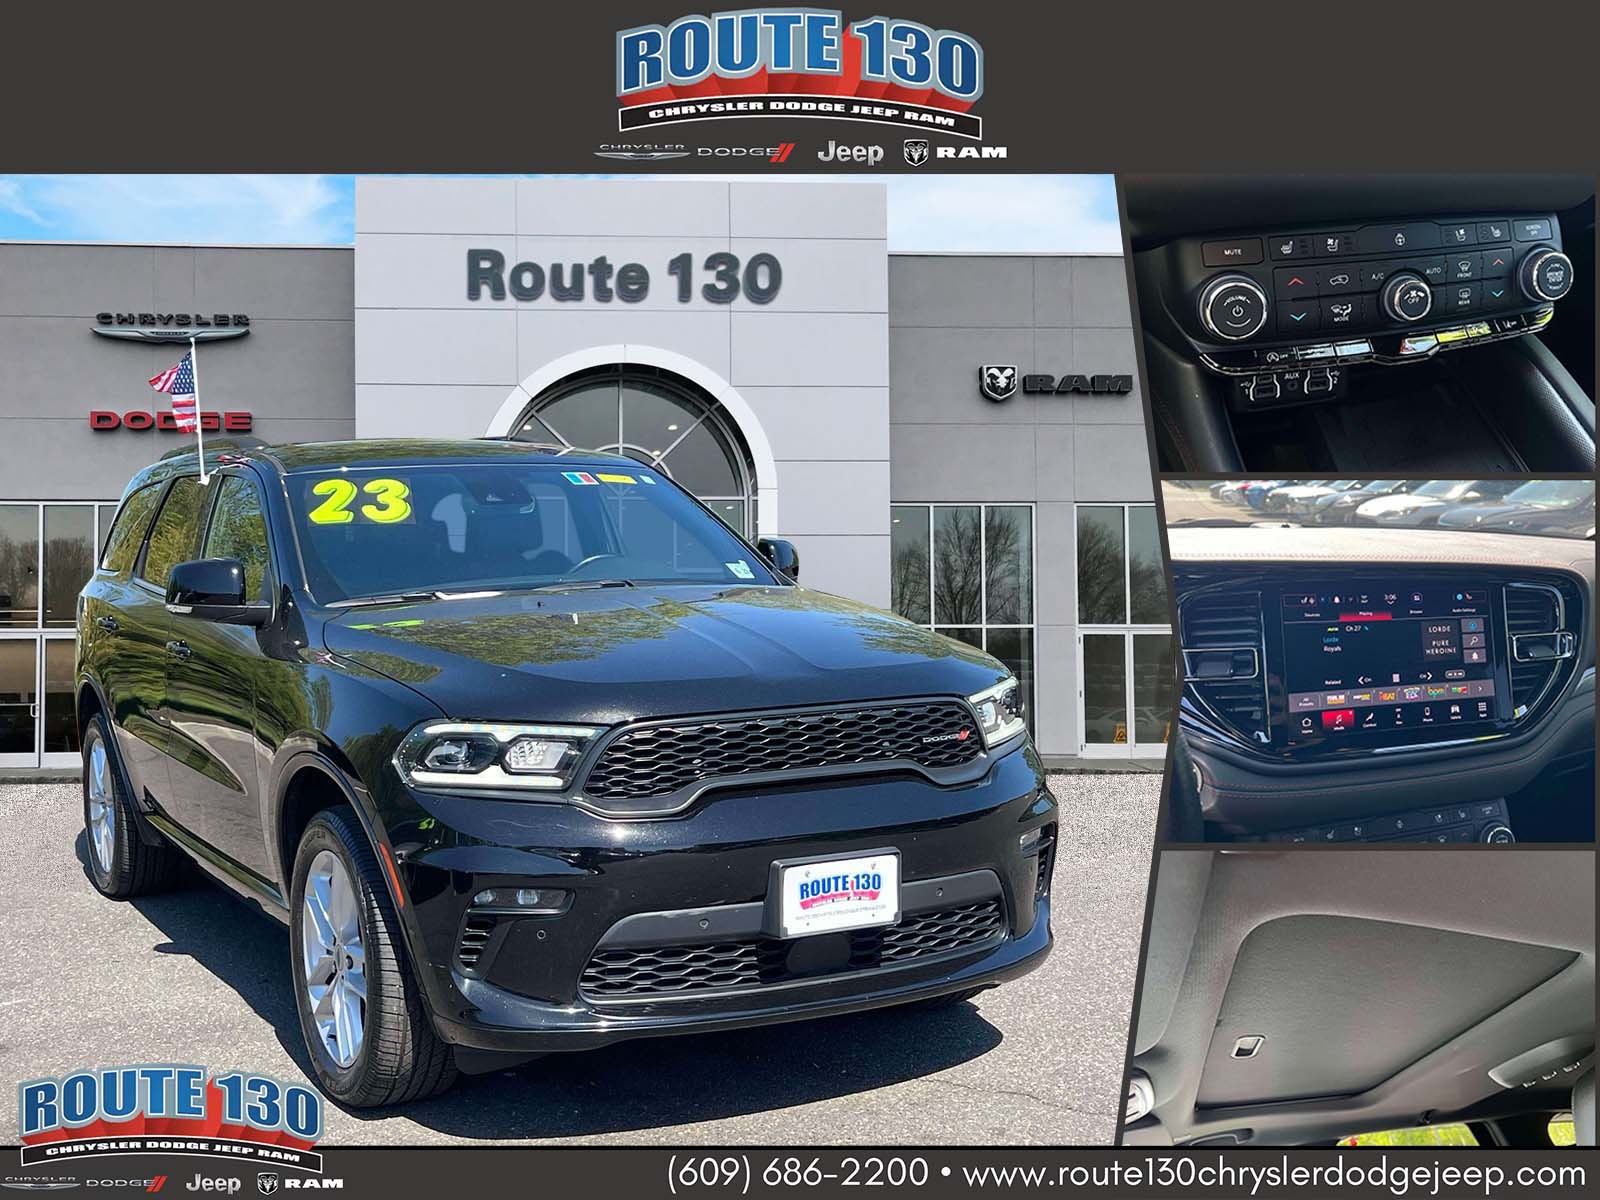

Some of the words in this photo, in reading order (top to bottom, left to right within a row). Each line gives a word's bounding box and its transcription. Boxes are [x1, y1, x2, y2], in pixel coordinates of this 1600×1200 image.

[467, 249, 650, 302] Route
[667, 252, 783, 305] 130
[1371, 272, 1385, 280] A/C
[1425, 267, 1442, 275] AUTO
[96, 312, 250, 327] CHRYSLER
[1023, 374, 1133, 394] RAM
[1284, 372, 1300, 380] AUX
[89, 411, 253, 432] DODGE
[308, 479, 412, 524] 23
[1425, 647, 1457, 655] HEROINE
[800, 875, 849, 900] ROUTE
[853, 873, 882, 890] 130
